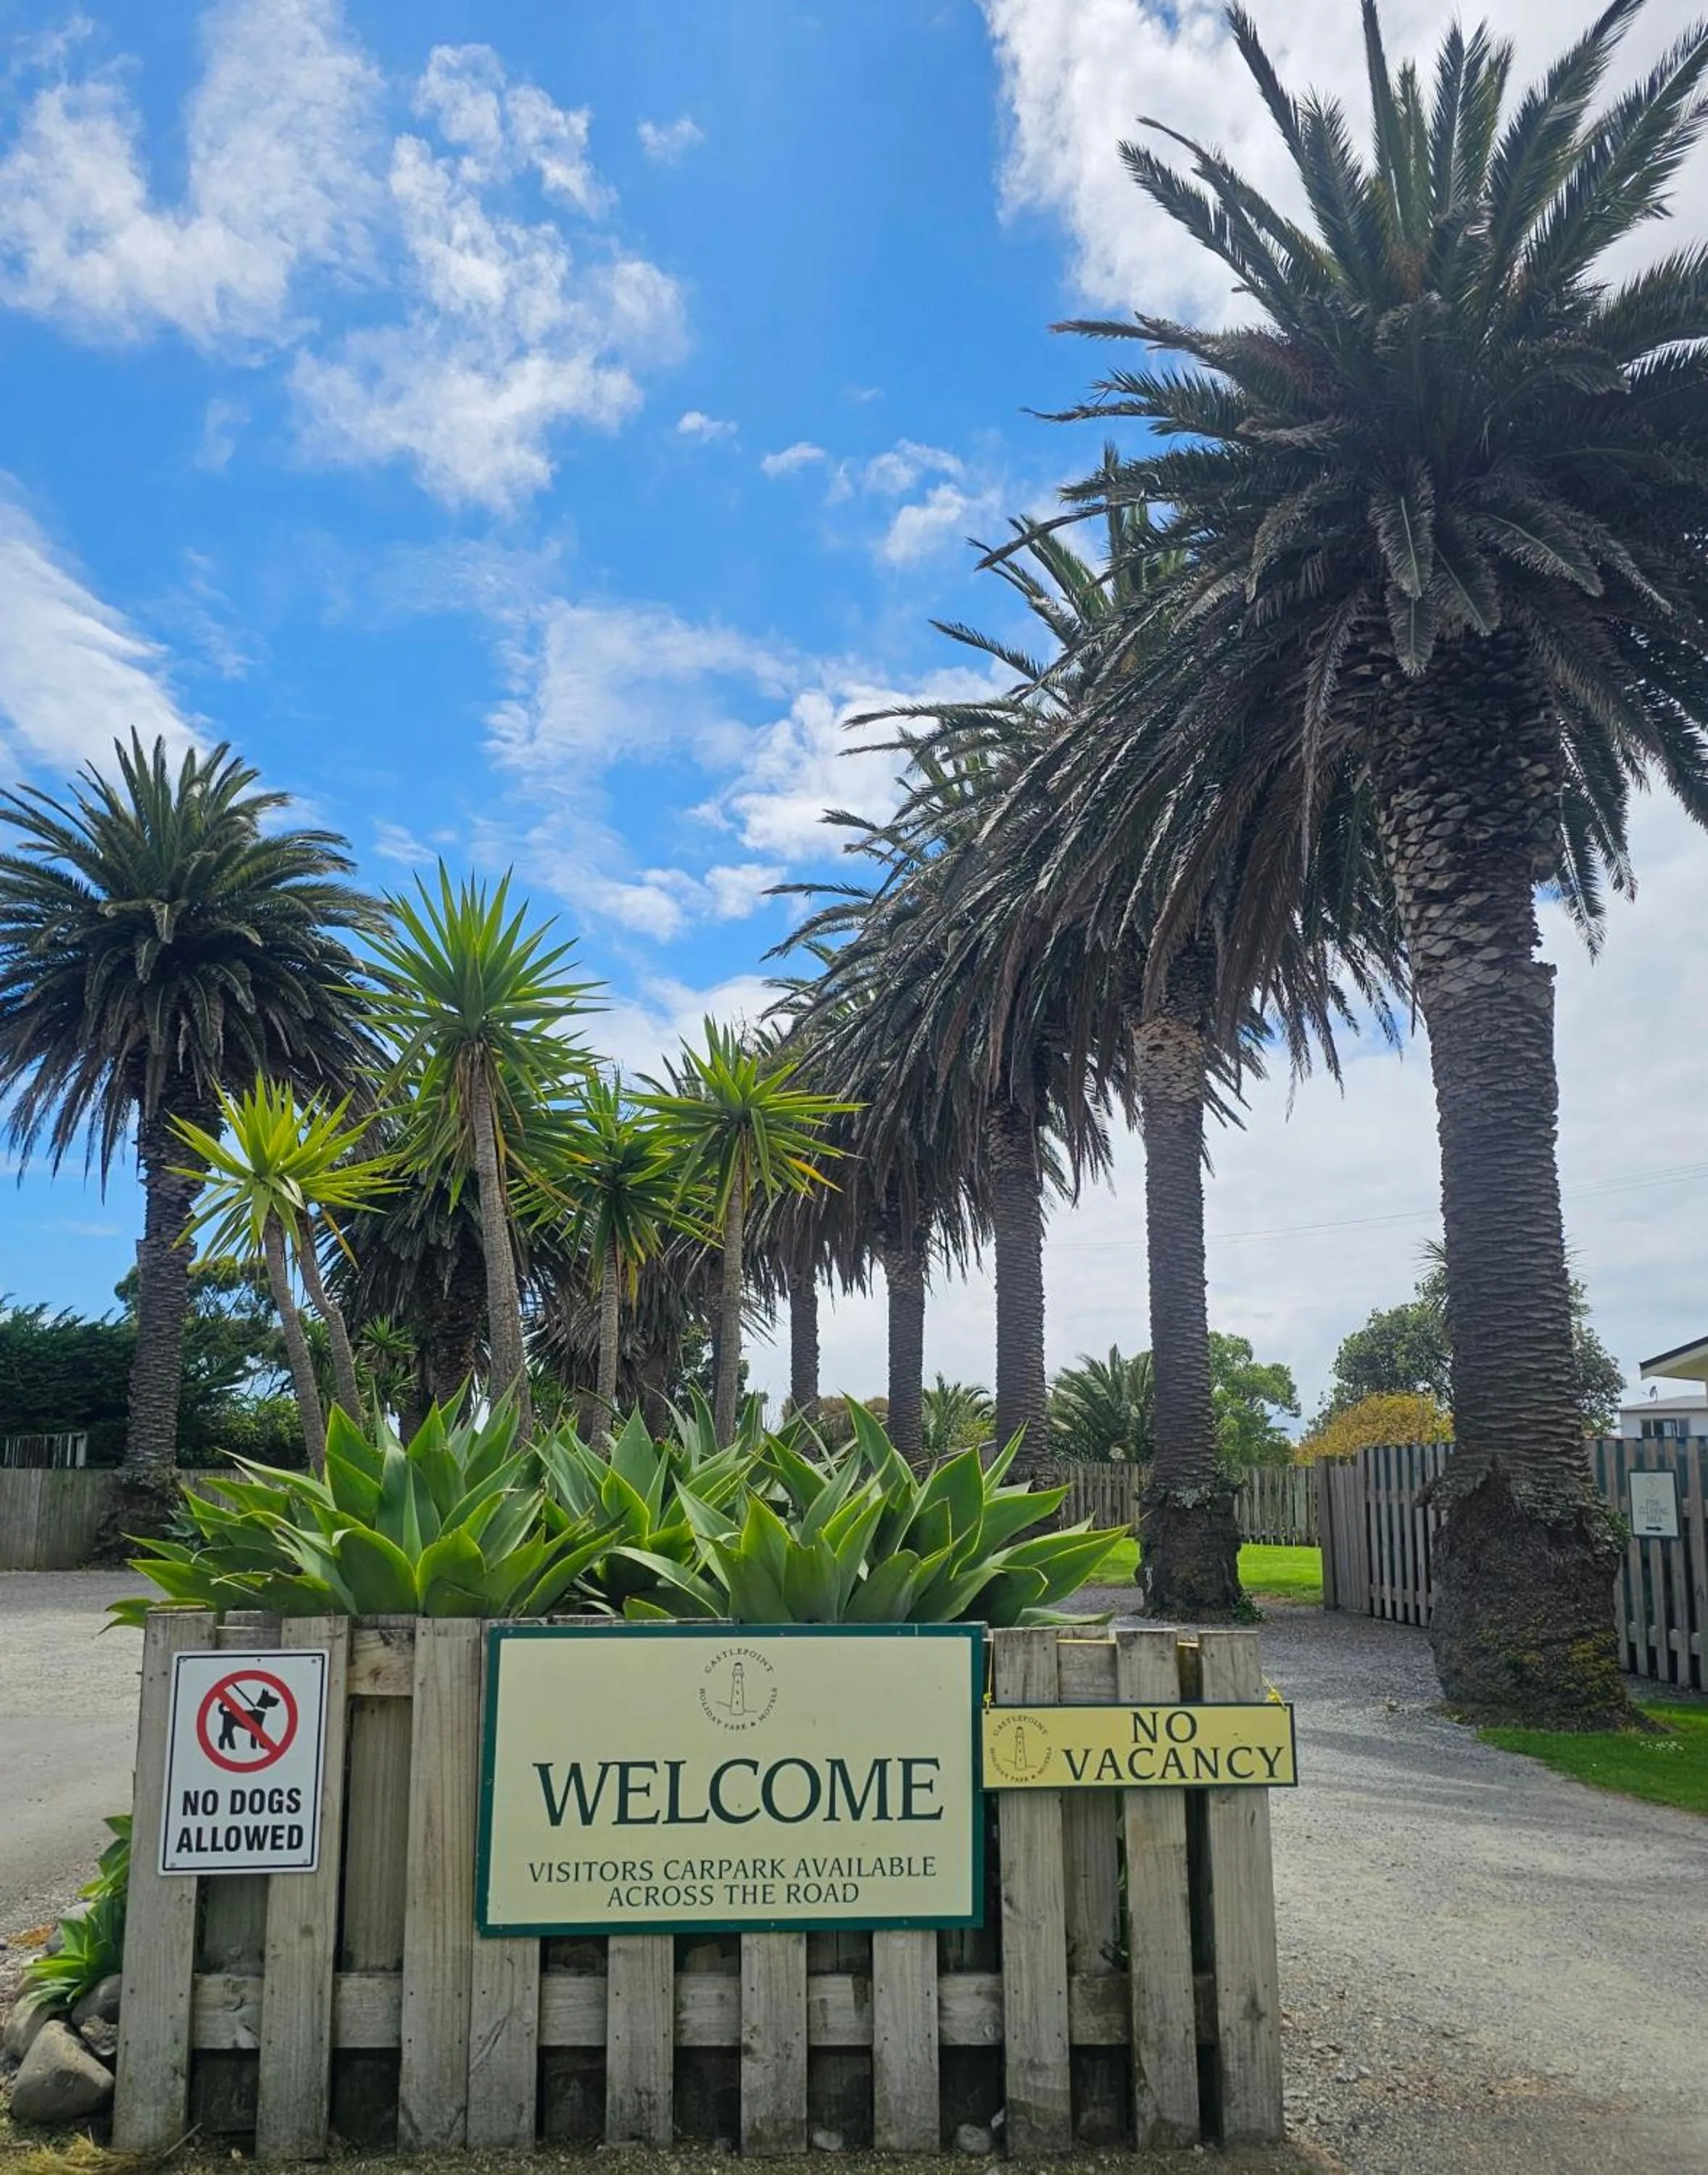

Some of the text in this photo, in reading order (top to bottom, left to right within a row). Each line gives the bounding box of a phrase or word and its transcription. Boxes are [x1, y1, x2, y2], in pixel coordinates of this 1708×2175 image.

[703, 1647, 774, 1673] CASTLEPOINT
[1130, 1710, 1198, 1744] NO
[1061, 1746, 1285, 1781] VACANCY
[182, 1787, 302, 1816] NO DOGS
[532, 1757, 944, 1827] WELCOME
[175, 1824, 304, 1854] ALLOWED
[528, 1856, 937, 1883] VISITORS CARPARK AVAILABLE
[607, 1882, 860, 1908] ACROSS THE ROAD
